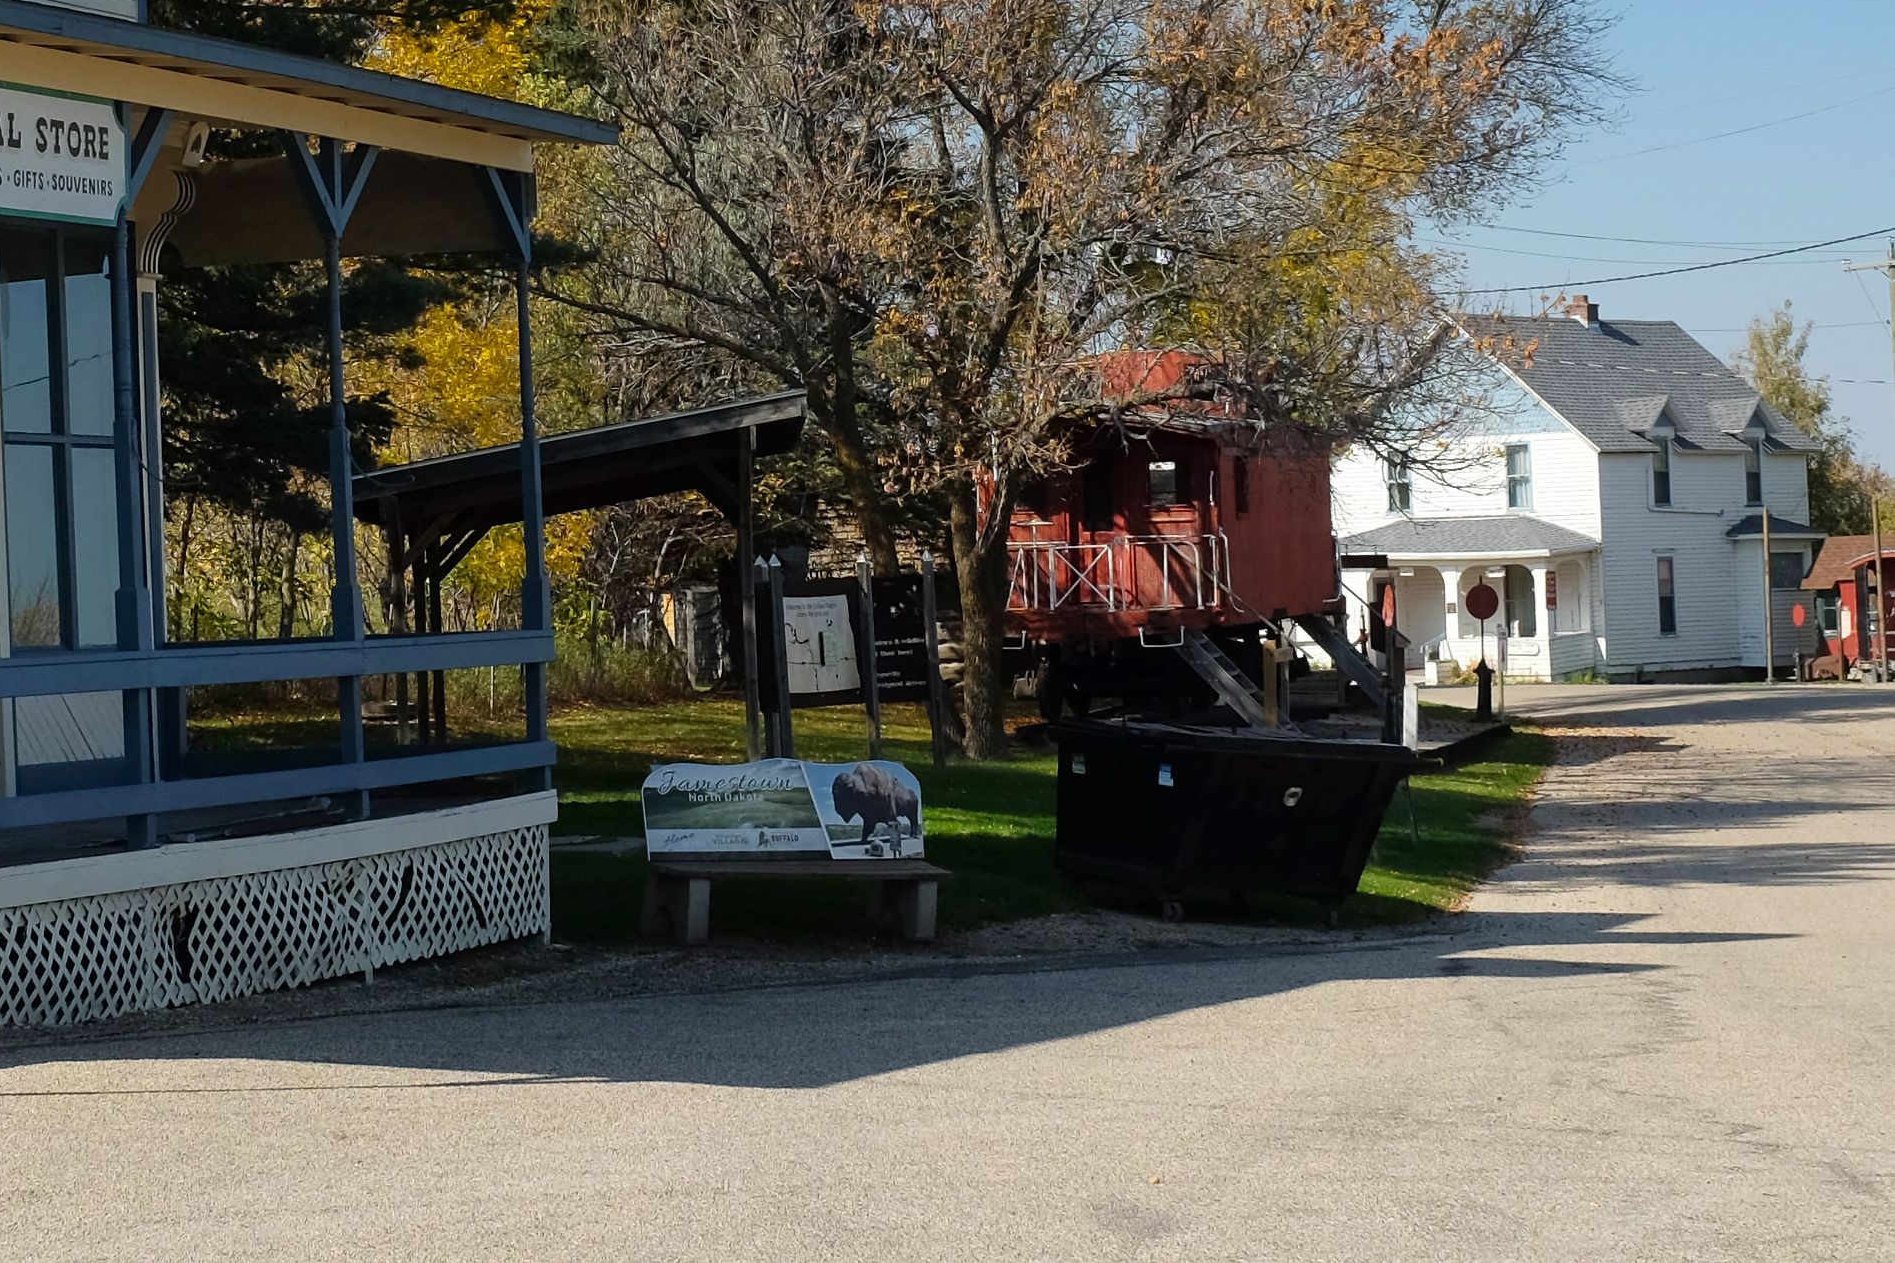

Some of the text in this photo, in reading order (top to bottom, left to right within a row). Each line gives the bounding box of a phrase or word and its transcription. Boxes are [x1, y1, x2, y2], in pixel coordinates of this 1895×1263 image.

[35, 117, 109, 160] STORE
[13, 169, 44, 190] GIFTS
[51, 174, 113, 197] SOUVENIRS
[657, 770, 794, 795] Jamestown
[688, 792, 764, 802] North Dakota
[770, 834, 799, 842] BUFFALO
